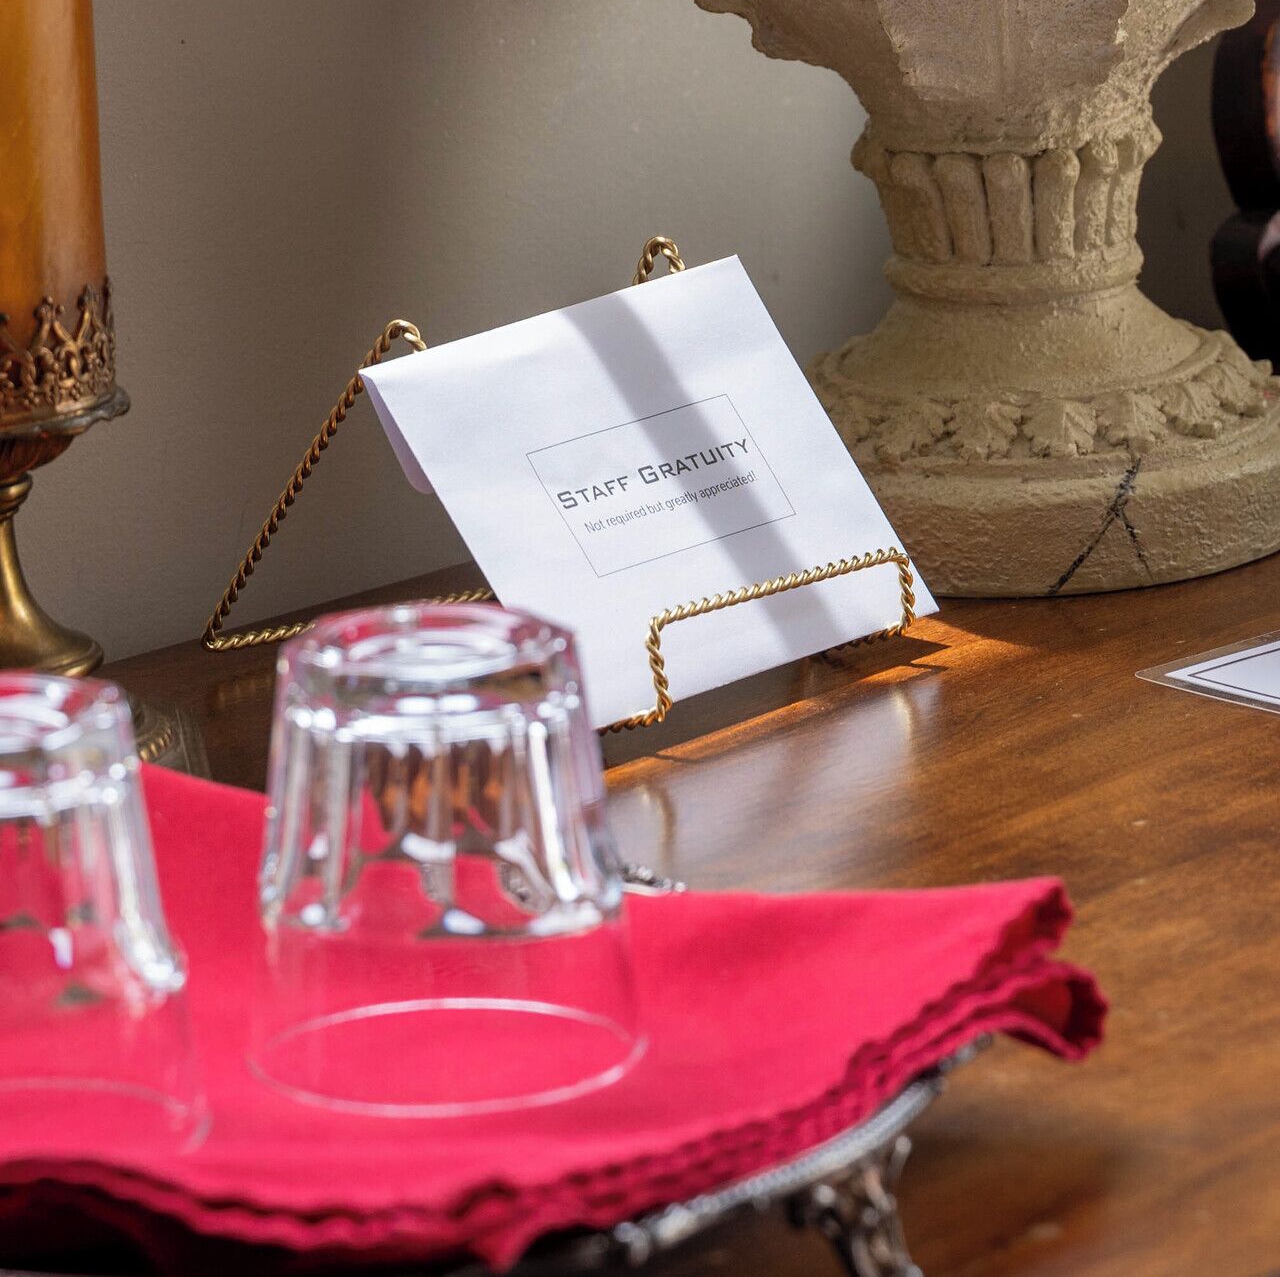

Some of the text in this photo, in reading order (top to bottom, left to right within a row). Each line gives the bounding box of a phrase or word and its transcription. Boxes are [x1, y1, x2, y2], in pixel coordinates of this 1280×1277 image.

[557, 438, 750, 510] STAFF GRATUITY
[584, 470, 758, 534] Not required but greatly appreciated!
